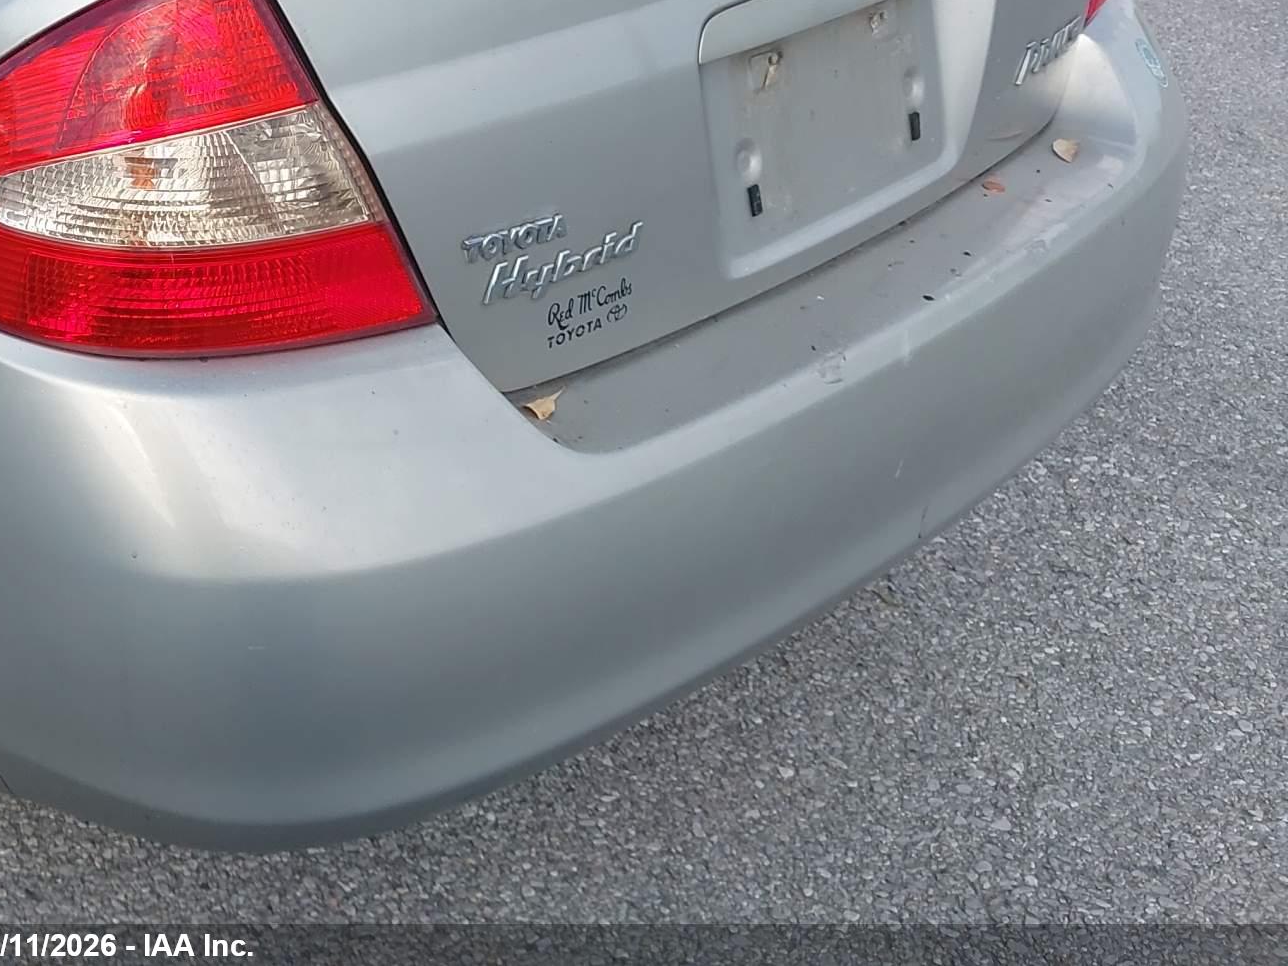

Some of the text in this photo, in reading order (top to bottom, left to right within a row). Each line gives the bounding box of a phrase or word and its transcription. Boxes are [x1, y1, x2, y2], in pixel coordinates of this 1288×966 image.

[462, 213, 568, 264] TOYOTA
[480, 220, 645, 306] Hybrid
[547, 297, 575, 330] Red
[547, 317, 603, 349] TOYOTA
